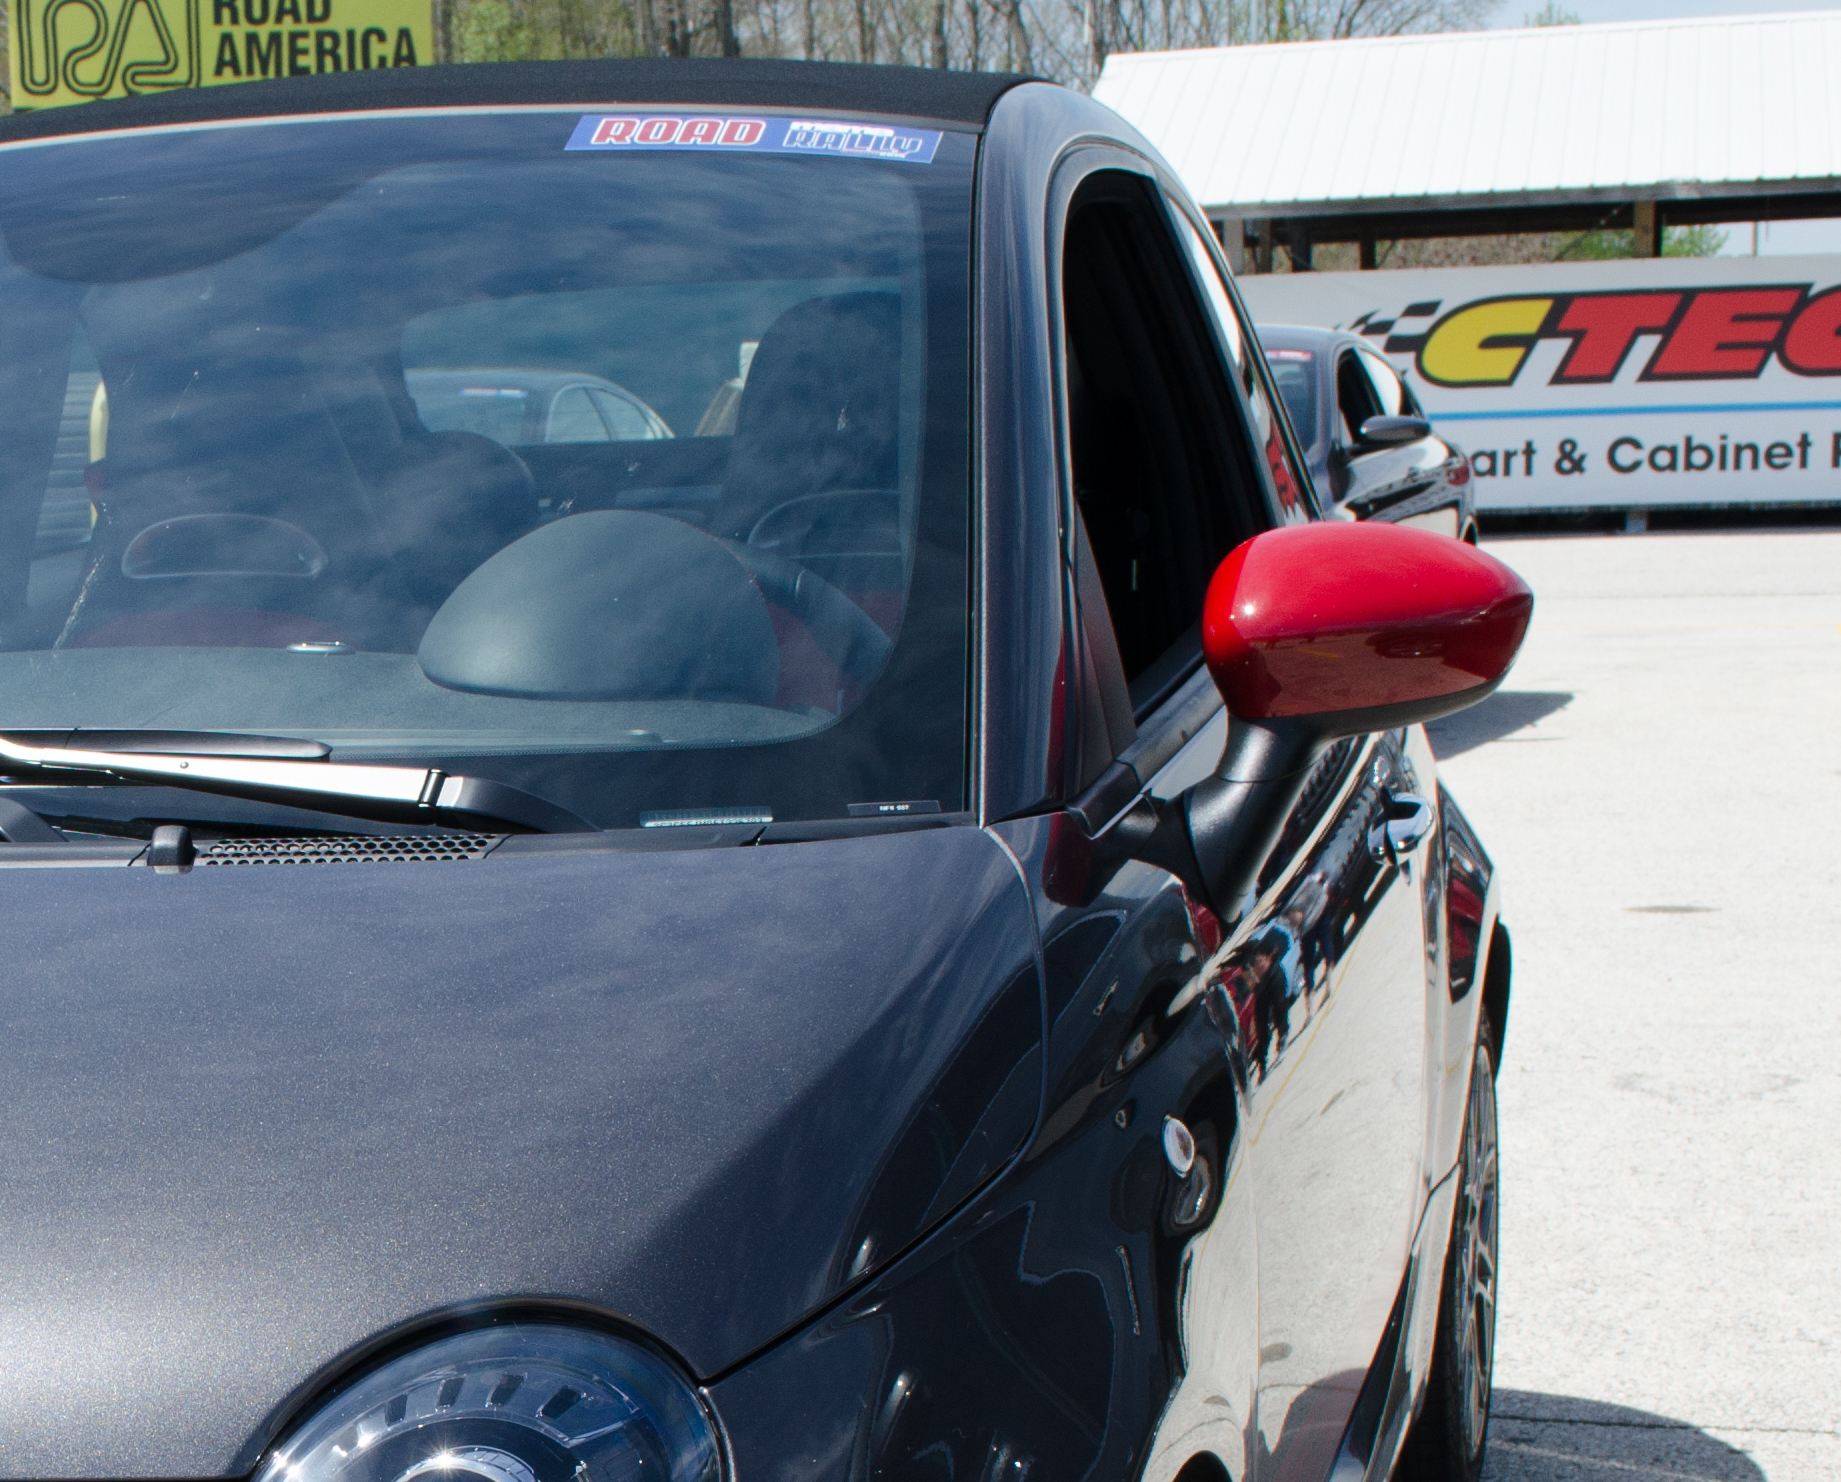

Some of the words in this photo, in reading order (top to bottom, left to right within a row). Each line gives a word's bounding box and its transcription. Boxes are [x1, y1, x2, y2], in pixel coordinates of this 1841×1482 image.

[213, 27, 419, 78] AMERICA
[591, 117, 766, 146] ROAD
[782, 128, 923, 158] RALLY
[1471, 440, 1537, 478] art
[1553, 438, 1587, 476] &
[1607, 432, 1813, 474] Cabinet
